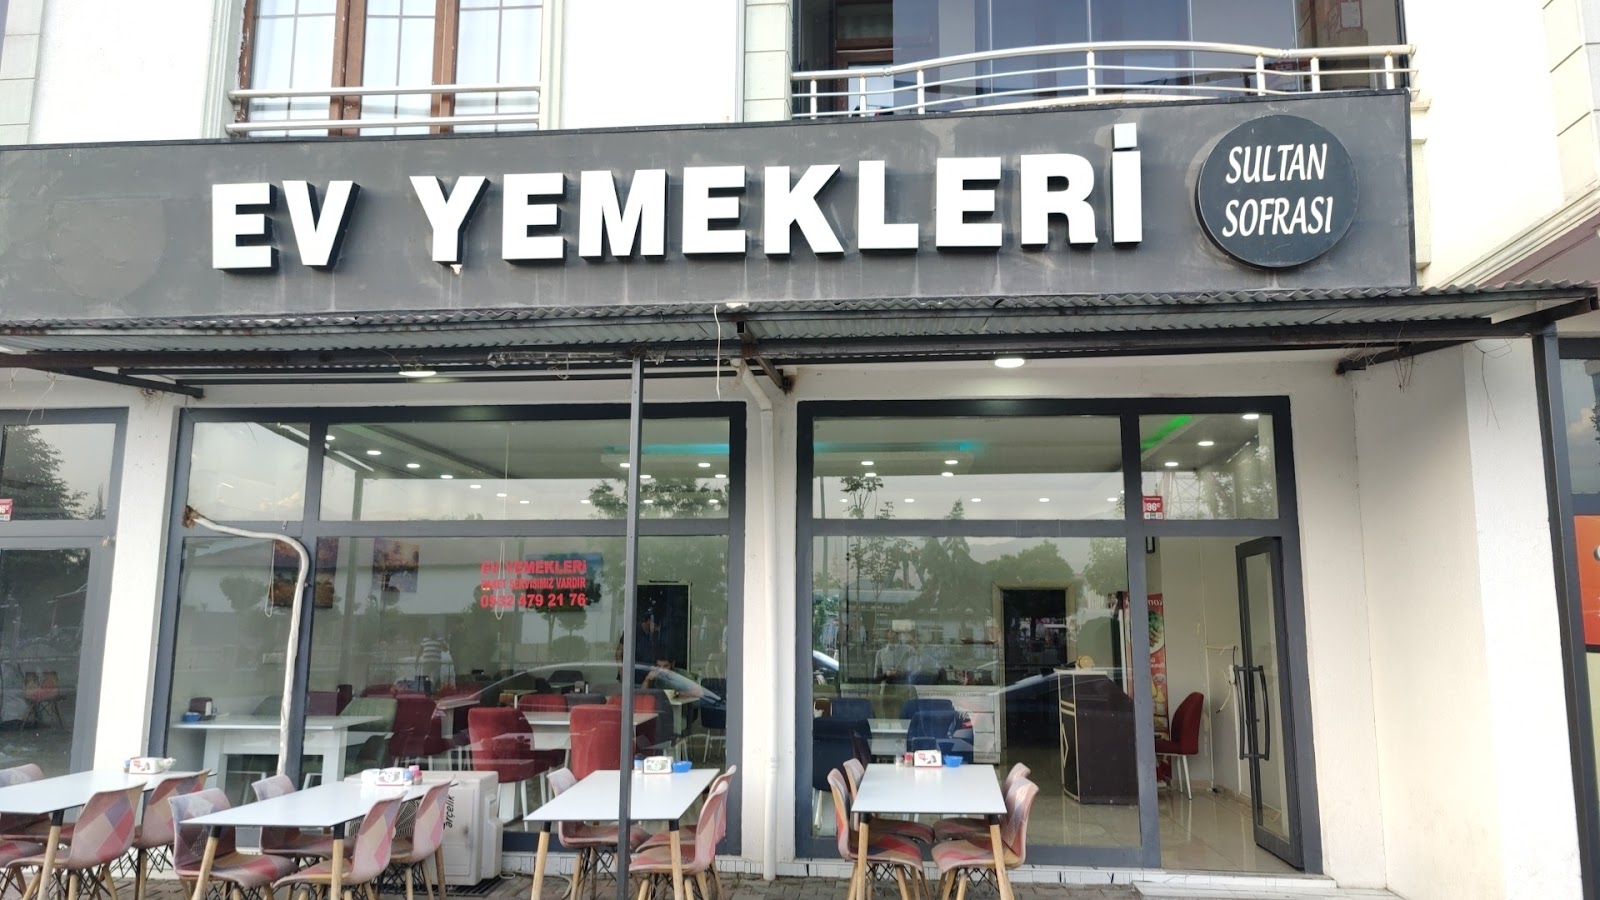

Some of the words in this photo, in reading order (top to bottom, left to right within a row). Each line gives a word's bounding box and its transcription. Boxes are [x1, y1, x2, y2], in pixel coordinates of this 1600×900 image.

[1225, 142, 1328, 185] SULTAN
[211, 180, 357, 269] EV
[410, 122, 1142, 262] YEMEKLERİ
[1221, 195, 1334, 238] SOFRASI
[481, 560, 500, 574] EV
[517, 593, 544, 607] 479
[547, 593, 564, 607] 21
[568, 592, 587, 607] 76
